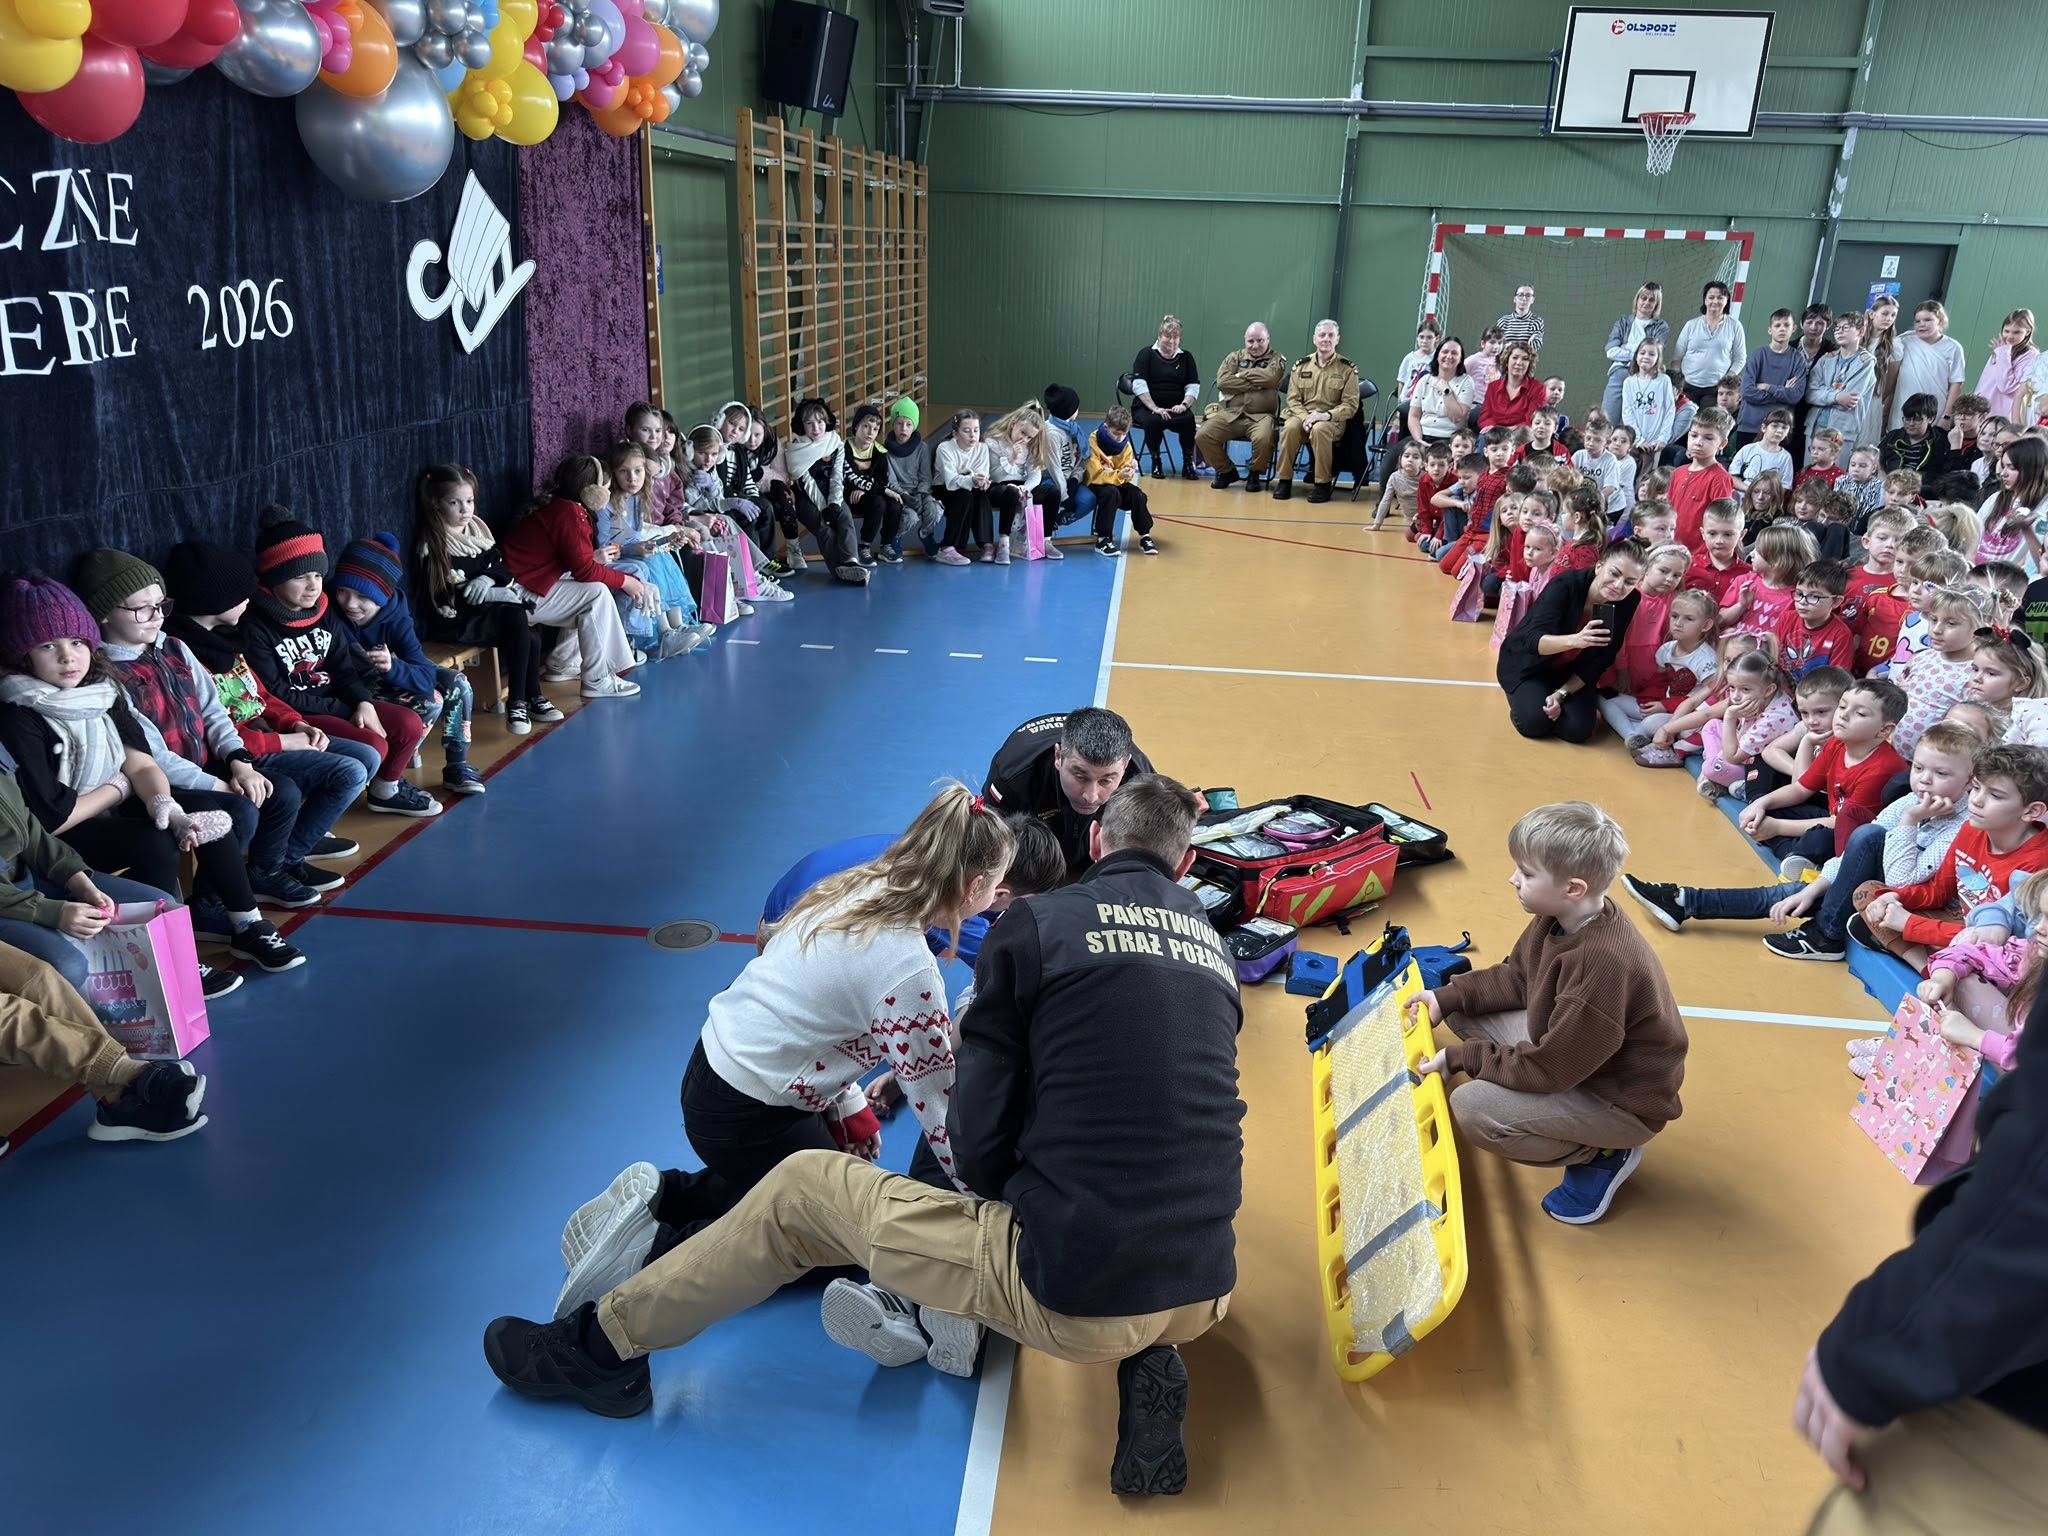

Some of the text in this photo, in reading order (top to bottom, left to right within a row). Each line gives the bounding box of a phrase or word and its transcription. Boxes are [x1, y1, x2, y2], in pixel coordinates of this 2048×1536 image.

[187, 278, 294, 350] 2026
[274, 627, 333, 673] SANTA
[1868, 635, 1890, 658] 19
[1096, 902, 1226, 957] PAŃSTWOWA
